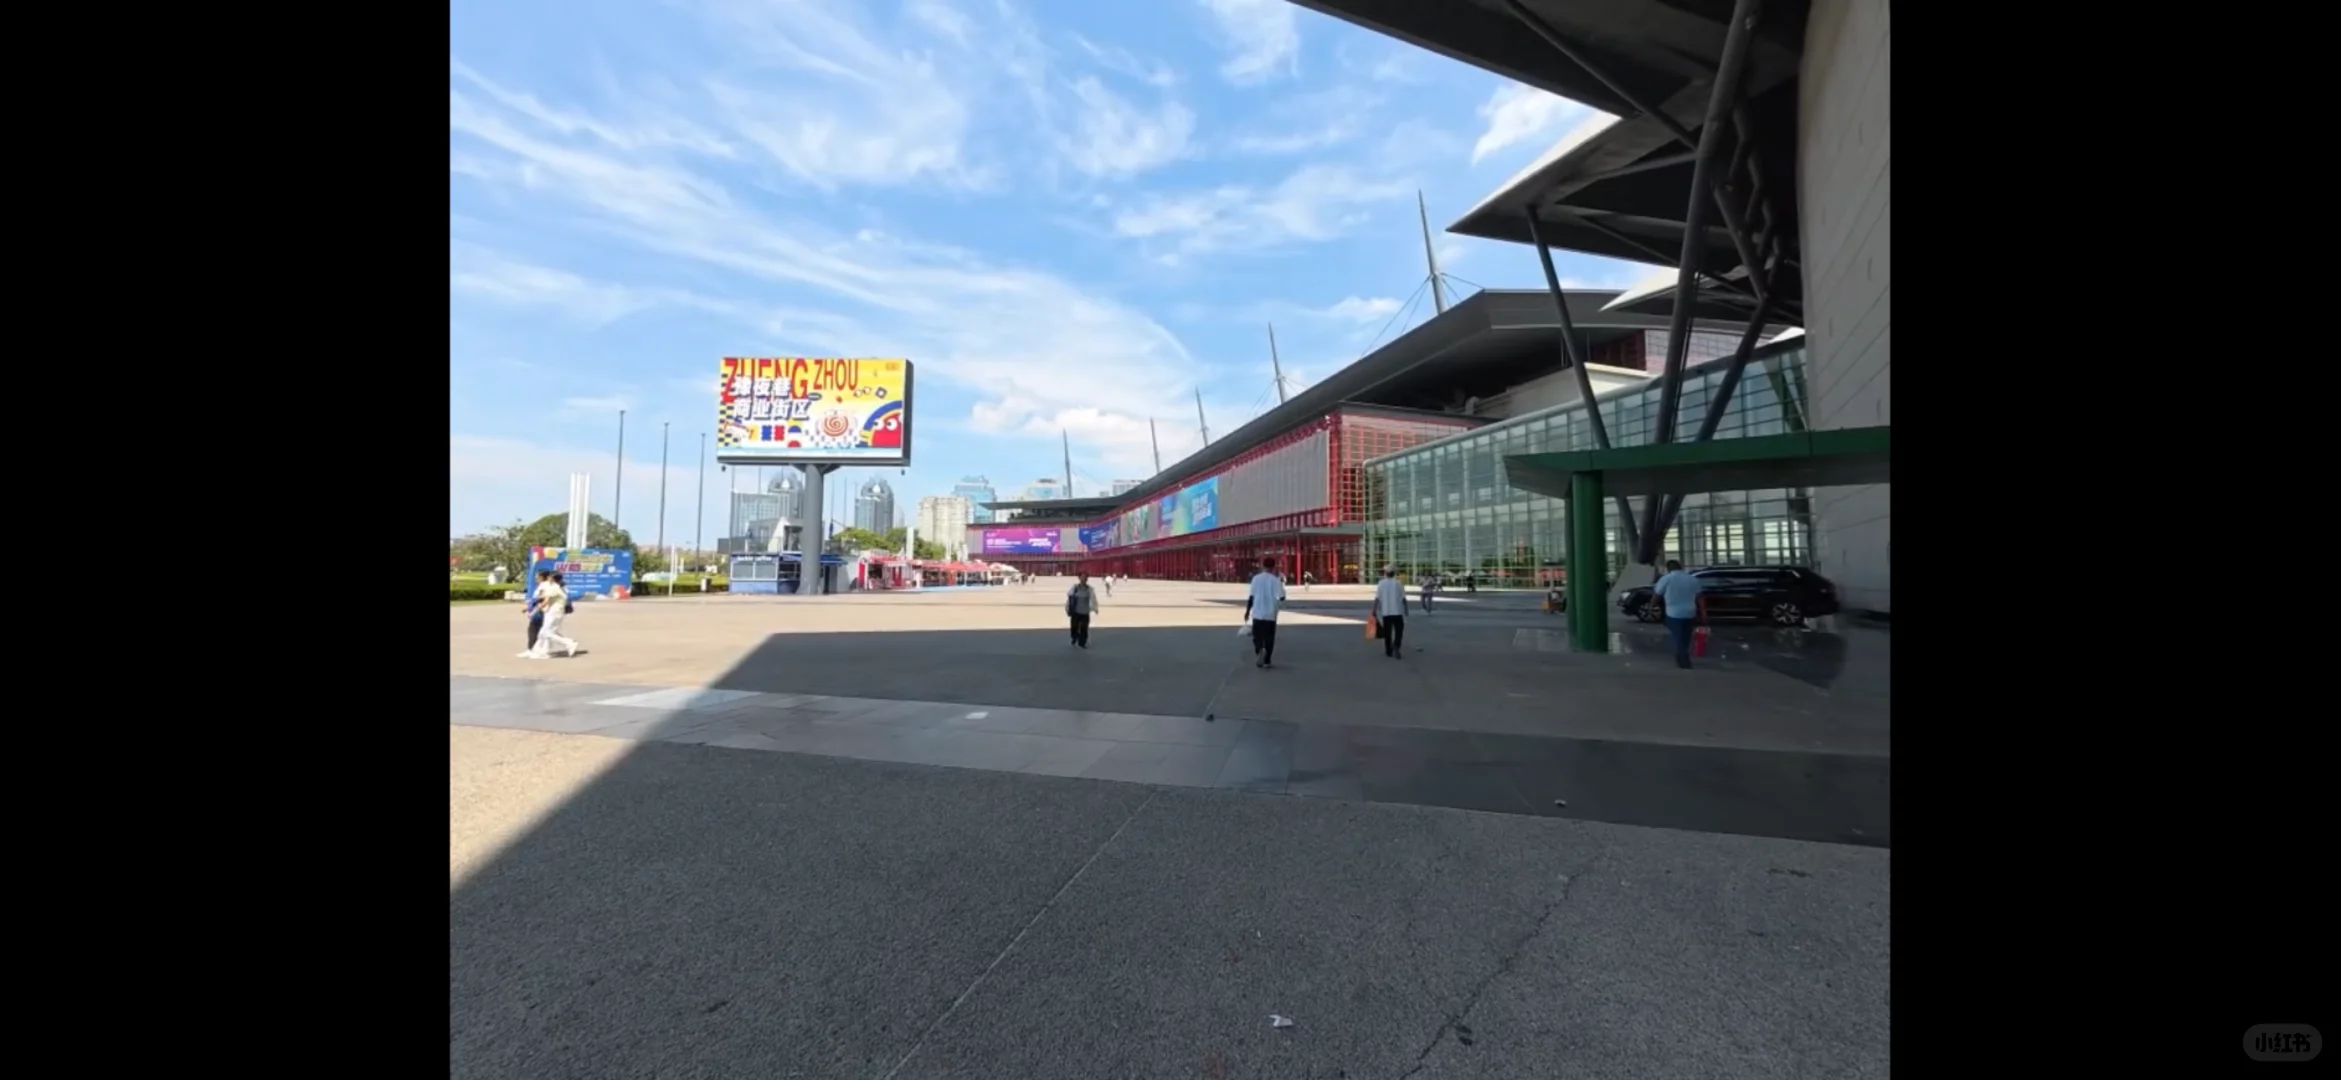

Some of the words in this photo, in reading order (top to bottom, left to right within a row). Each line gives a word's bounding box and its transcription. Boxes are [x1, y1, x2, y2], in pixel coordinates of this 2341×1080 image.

[813, 358, 859, 391] ZHOU
[733, 398, 810, 419] 商业街区
